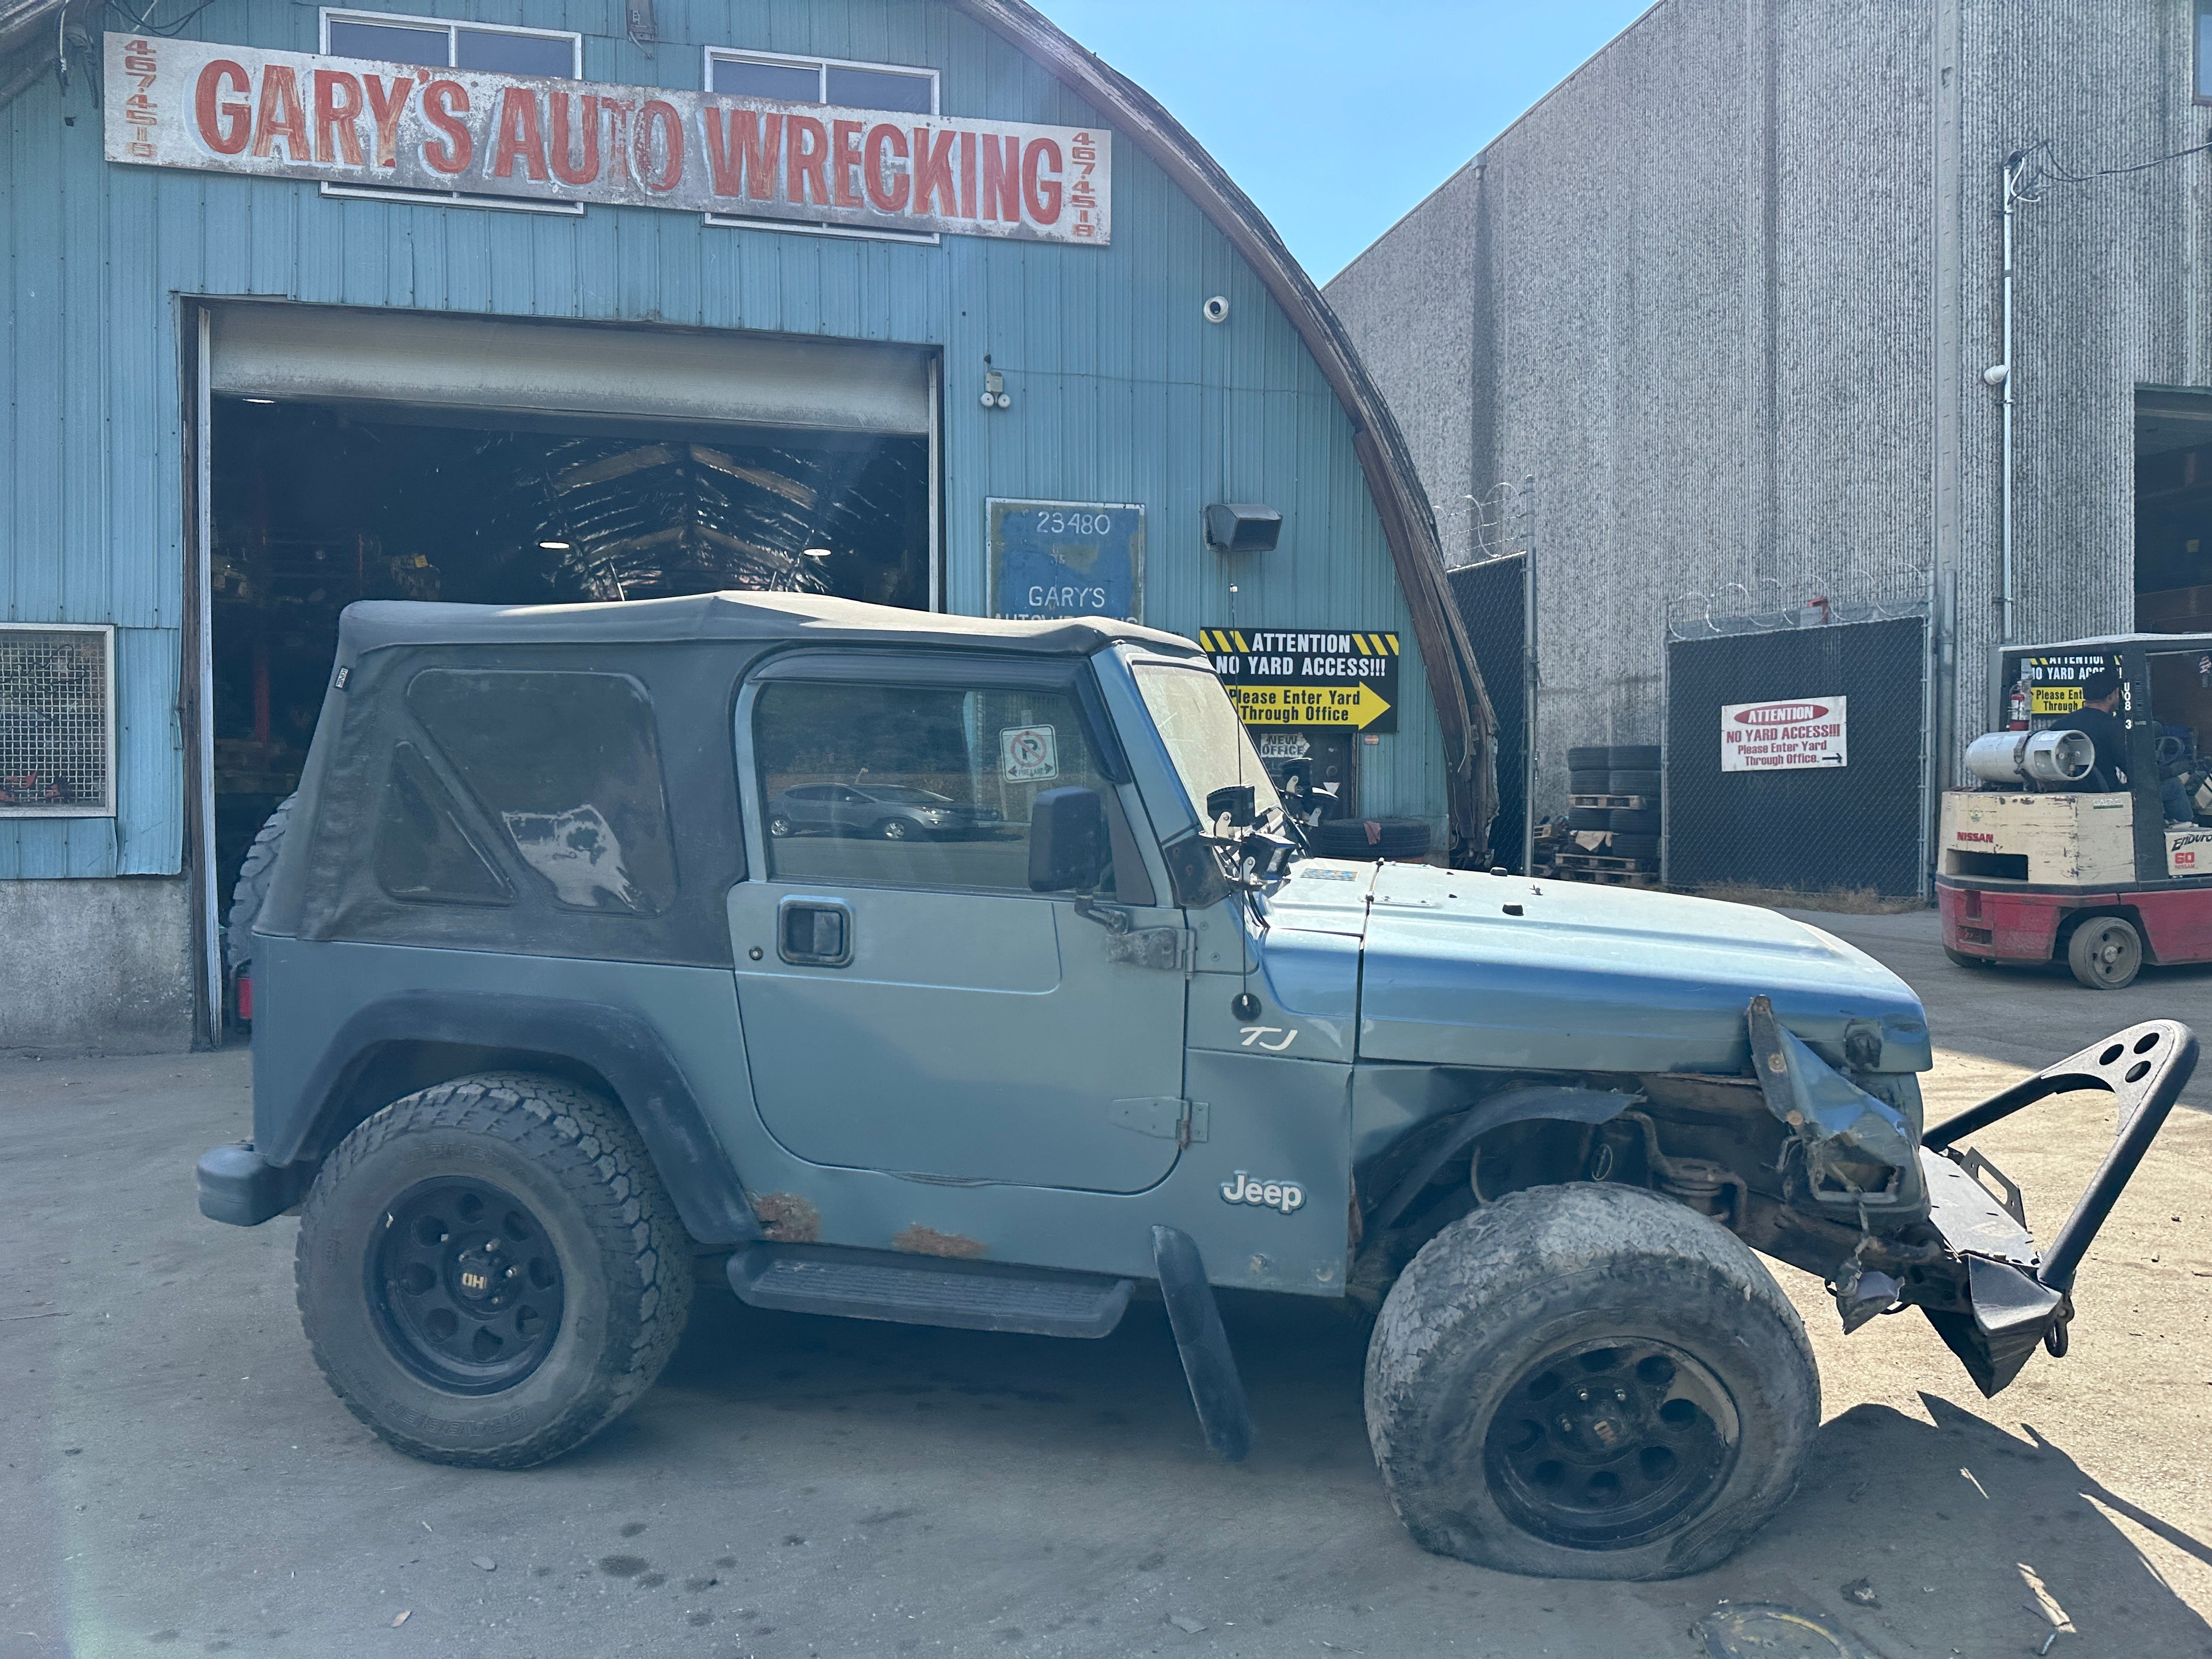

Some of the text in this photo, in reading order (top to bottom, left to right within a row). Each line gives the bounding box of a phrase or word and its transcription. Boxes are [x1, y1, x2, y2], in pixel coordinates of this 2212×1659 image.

[195, 59, 1063, 225] GARY'S AUTO WRECKING
[1037, 511, 1111, 535] 23480
[1029, 586, 1105, 608] GARY'S
[1252, 633, 1350, 653] ATTENTION
[1216, 656, 1385, 676] NO YARD ACCESS!!!
[2047, 667, 2074, 680] YARD
[1229, 689, 1360, 705] Please Enter Yard
[2036, 690, 2064, 700] Please
[1240, 706, 1349, 723] Through Office
[2043, 700, 2078, 713] Through
[1748, 706, 1814, 724] ATTENTION
[1268, 735, 1297, 744] NEW
[1726, 724, 1840, 743] NO YARD ACCESS!!!
[1262, 745, 1305, 755] OFFICE
[1738, 740, 1827, 755] Please Enter Yard
[1745, 755, 1784, 766] Through
[1957, 831, 1994, 843] NISSAN
[2175, 851, 2195, 863] 60
[1240, 1027, 1298, 1051] TJ
[1223, 1174, 1302, 1211] Jeep
